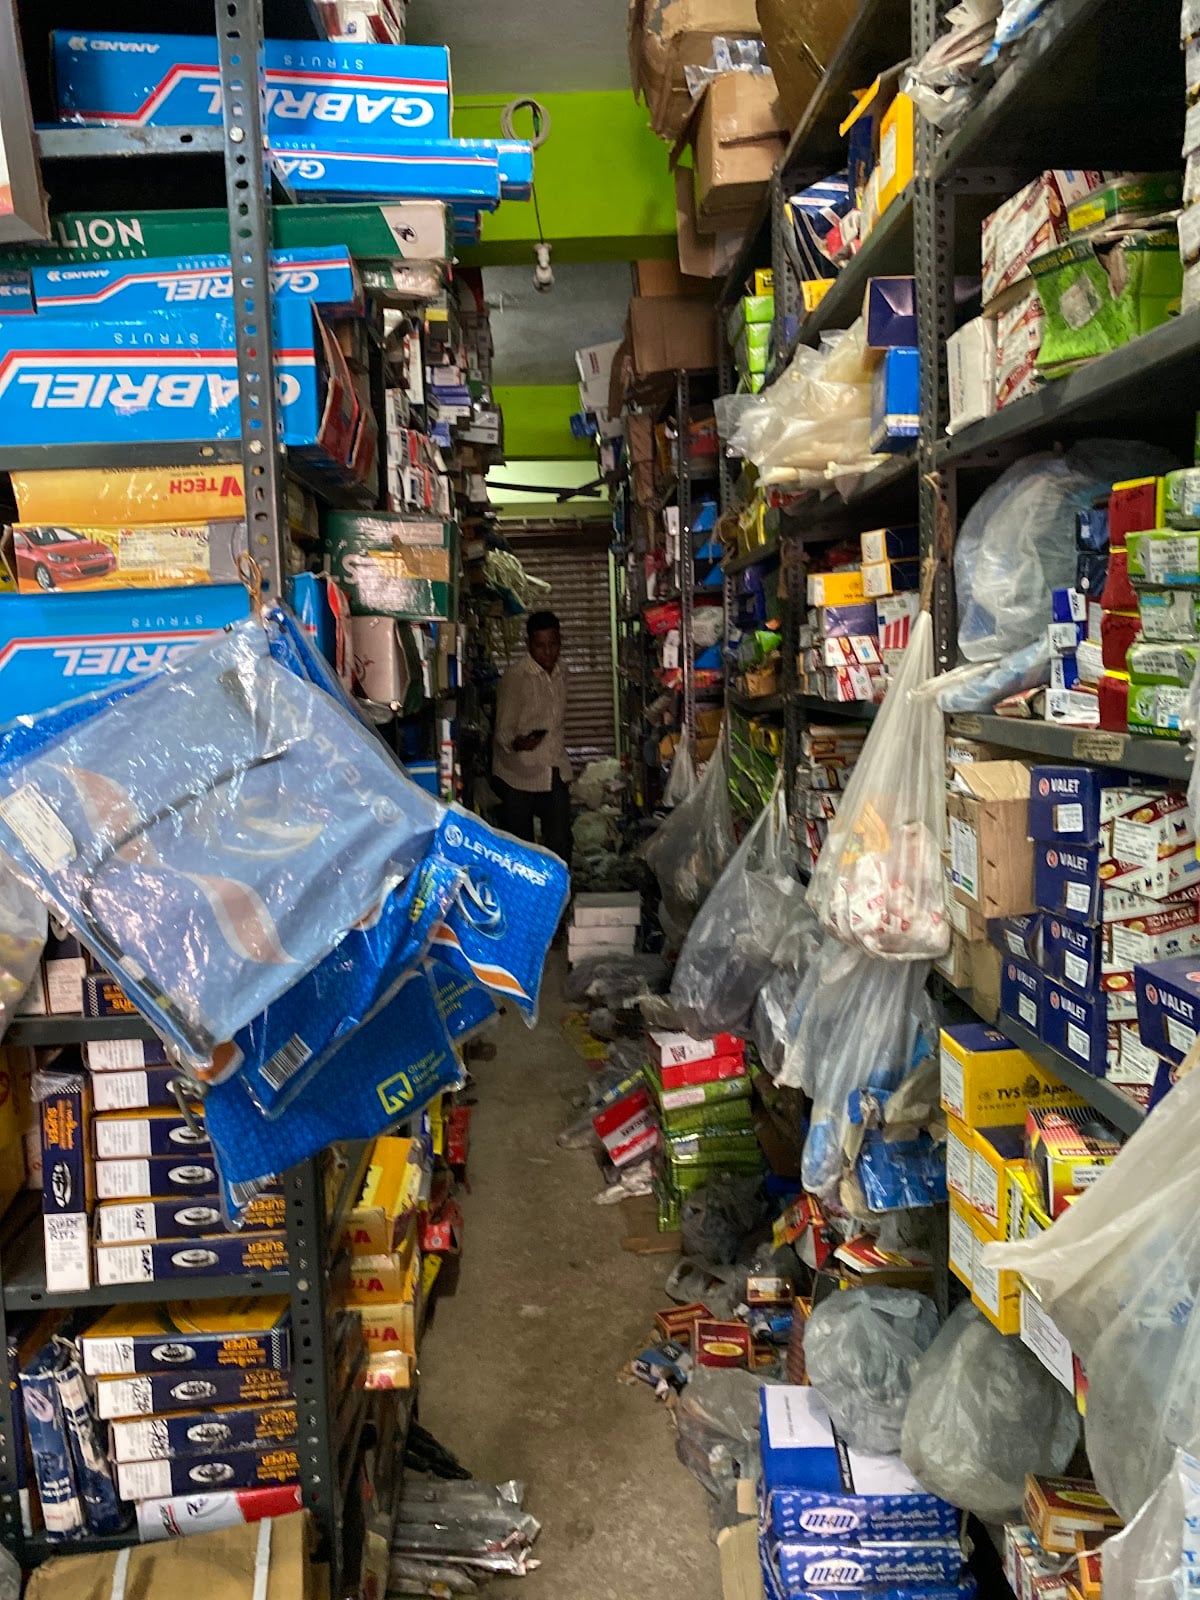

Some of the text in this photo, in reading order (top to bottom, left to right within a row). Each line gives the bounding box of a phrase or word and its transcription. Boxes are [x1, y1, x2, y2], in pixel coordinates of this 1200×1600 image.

[90, 39, 160, 54] ANAND
[283, 55, 364, 71] STRUTS
[62, 269, 110, 281] ANAND
[157, 270, 320, 302] GARIEL
[113, 332, 200, 345] STRUTS
[169, 476, 218, 494] TECH
[132, 615, 204, 627] STRUTS
[1050, 777, 1080, 794] VALET
[1058, 851, 1089, 873] VALET
[1060, 923, 1089, 949] VALET
[1016, 967, 1037, 992] VALET
[1060, 994, 1087, 1022] VALET
[1157, 988, 1195, 1020] VALET
[996, 1086, 1021, 1100] TVS
[247, 1240, 285, 1254] SUPER
[221, 1337, 259, 1351] SUPER
[260, 1451, 299, 1466] SUPER
